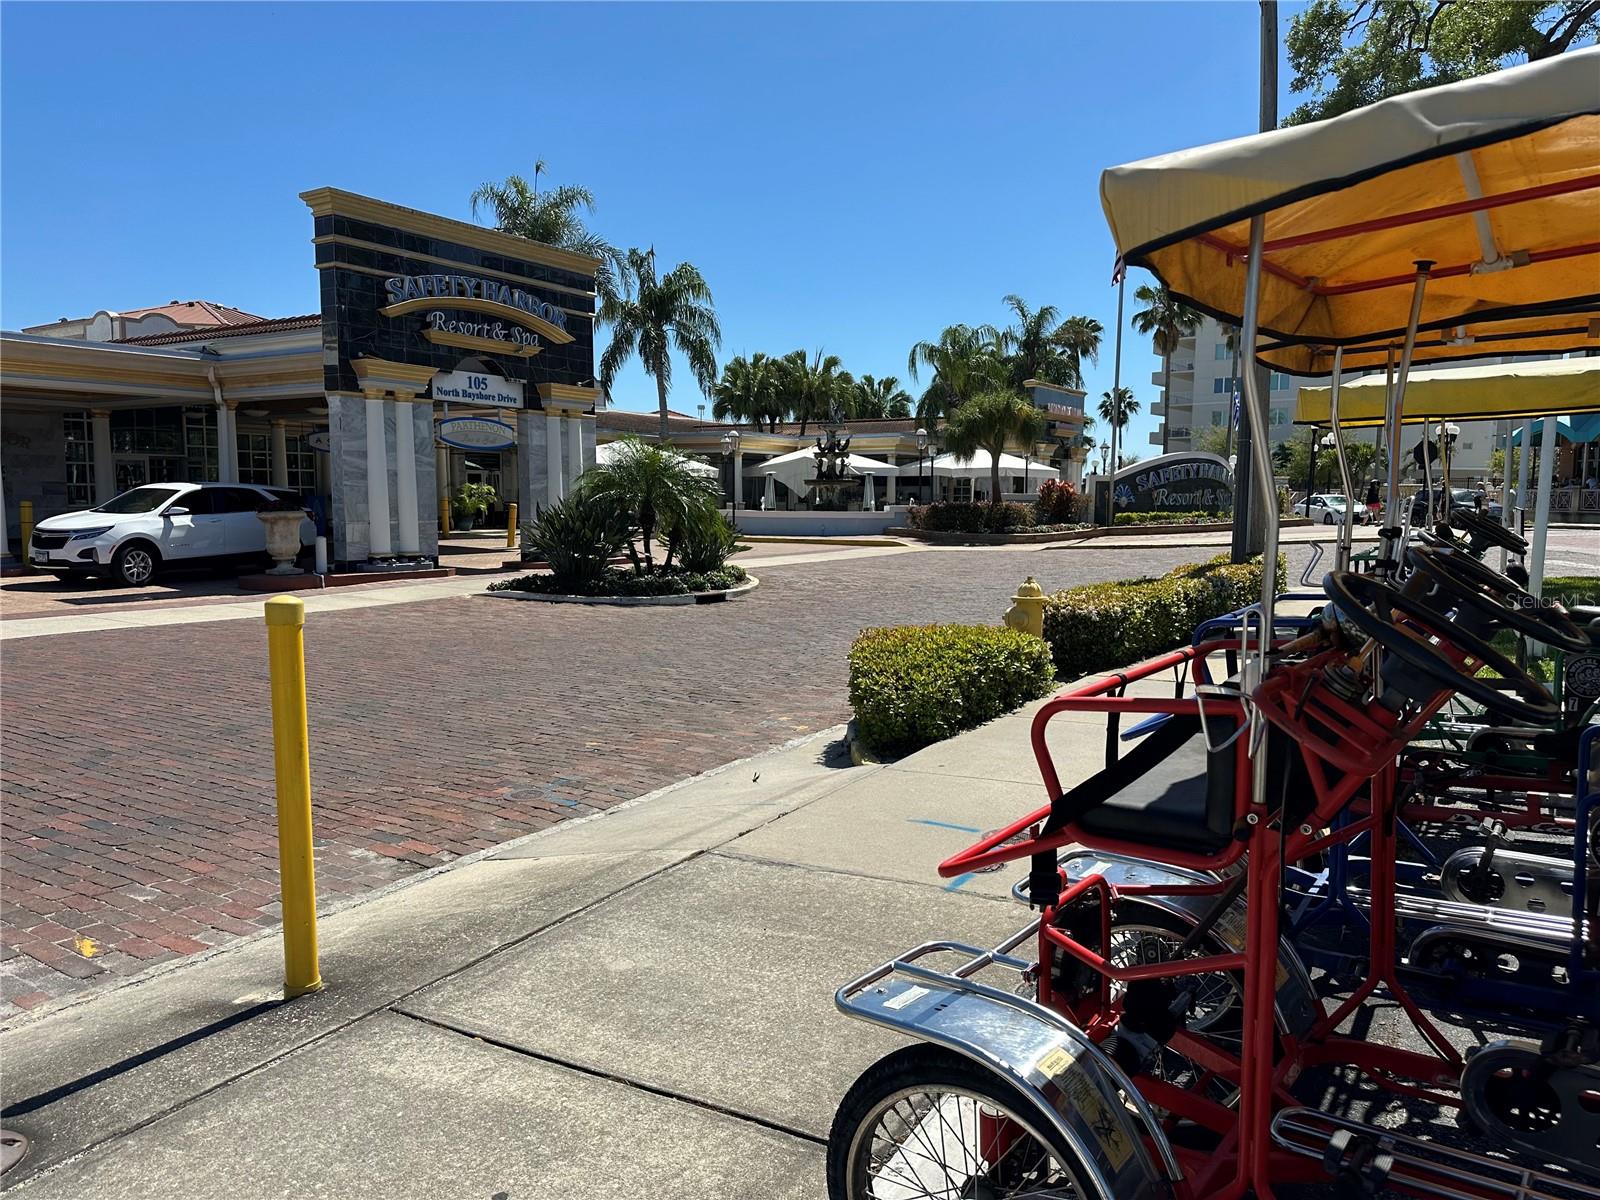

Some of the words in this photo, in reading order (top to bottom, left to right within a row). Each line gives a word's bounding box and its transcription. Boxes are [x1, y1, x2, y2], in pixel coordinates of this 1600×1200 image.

[385, 275, 480, 304] SAFETY
[481, 279, 568, 331] HARBOR
[427, 311, 490, 338] Resort
[492, 321, 508, 341] &
[512, 326, 540, 347] Spa
[436, 386, 460, 398] North
[462, 389, 496, 401] Bayshore
[498, 393, 517, 404] Drive
[467, 376, 488, 391] 105
[1135, 463, 1198, 492] SAFETY
[1155, 488, 1203, 506] Resort
